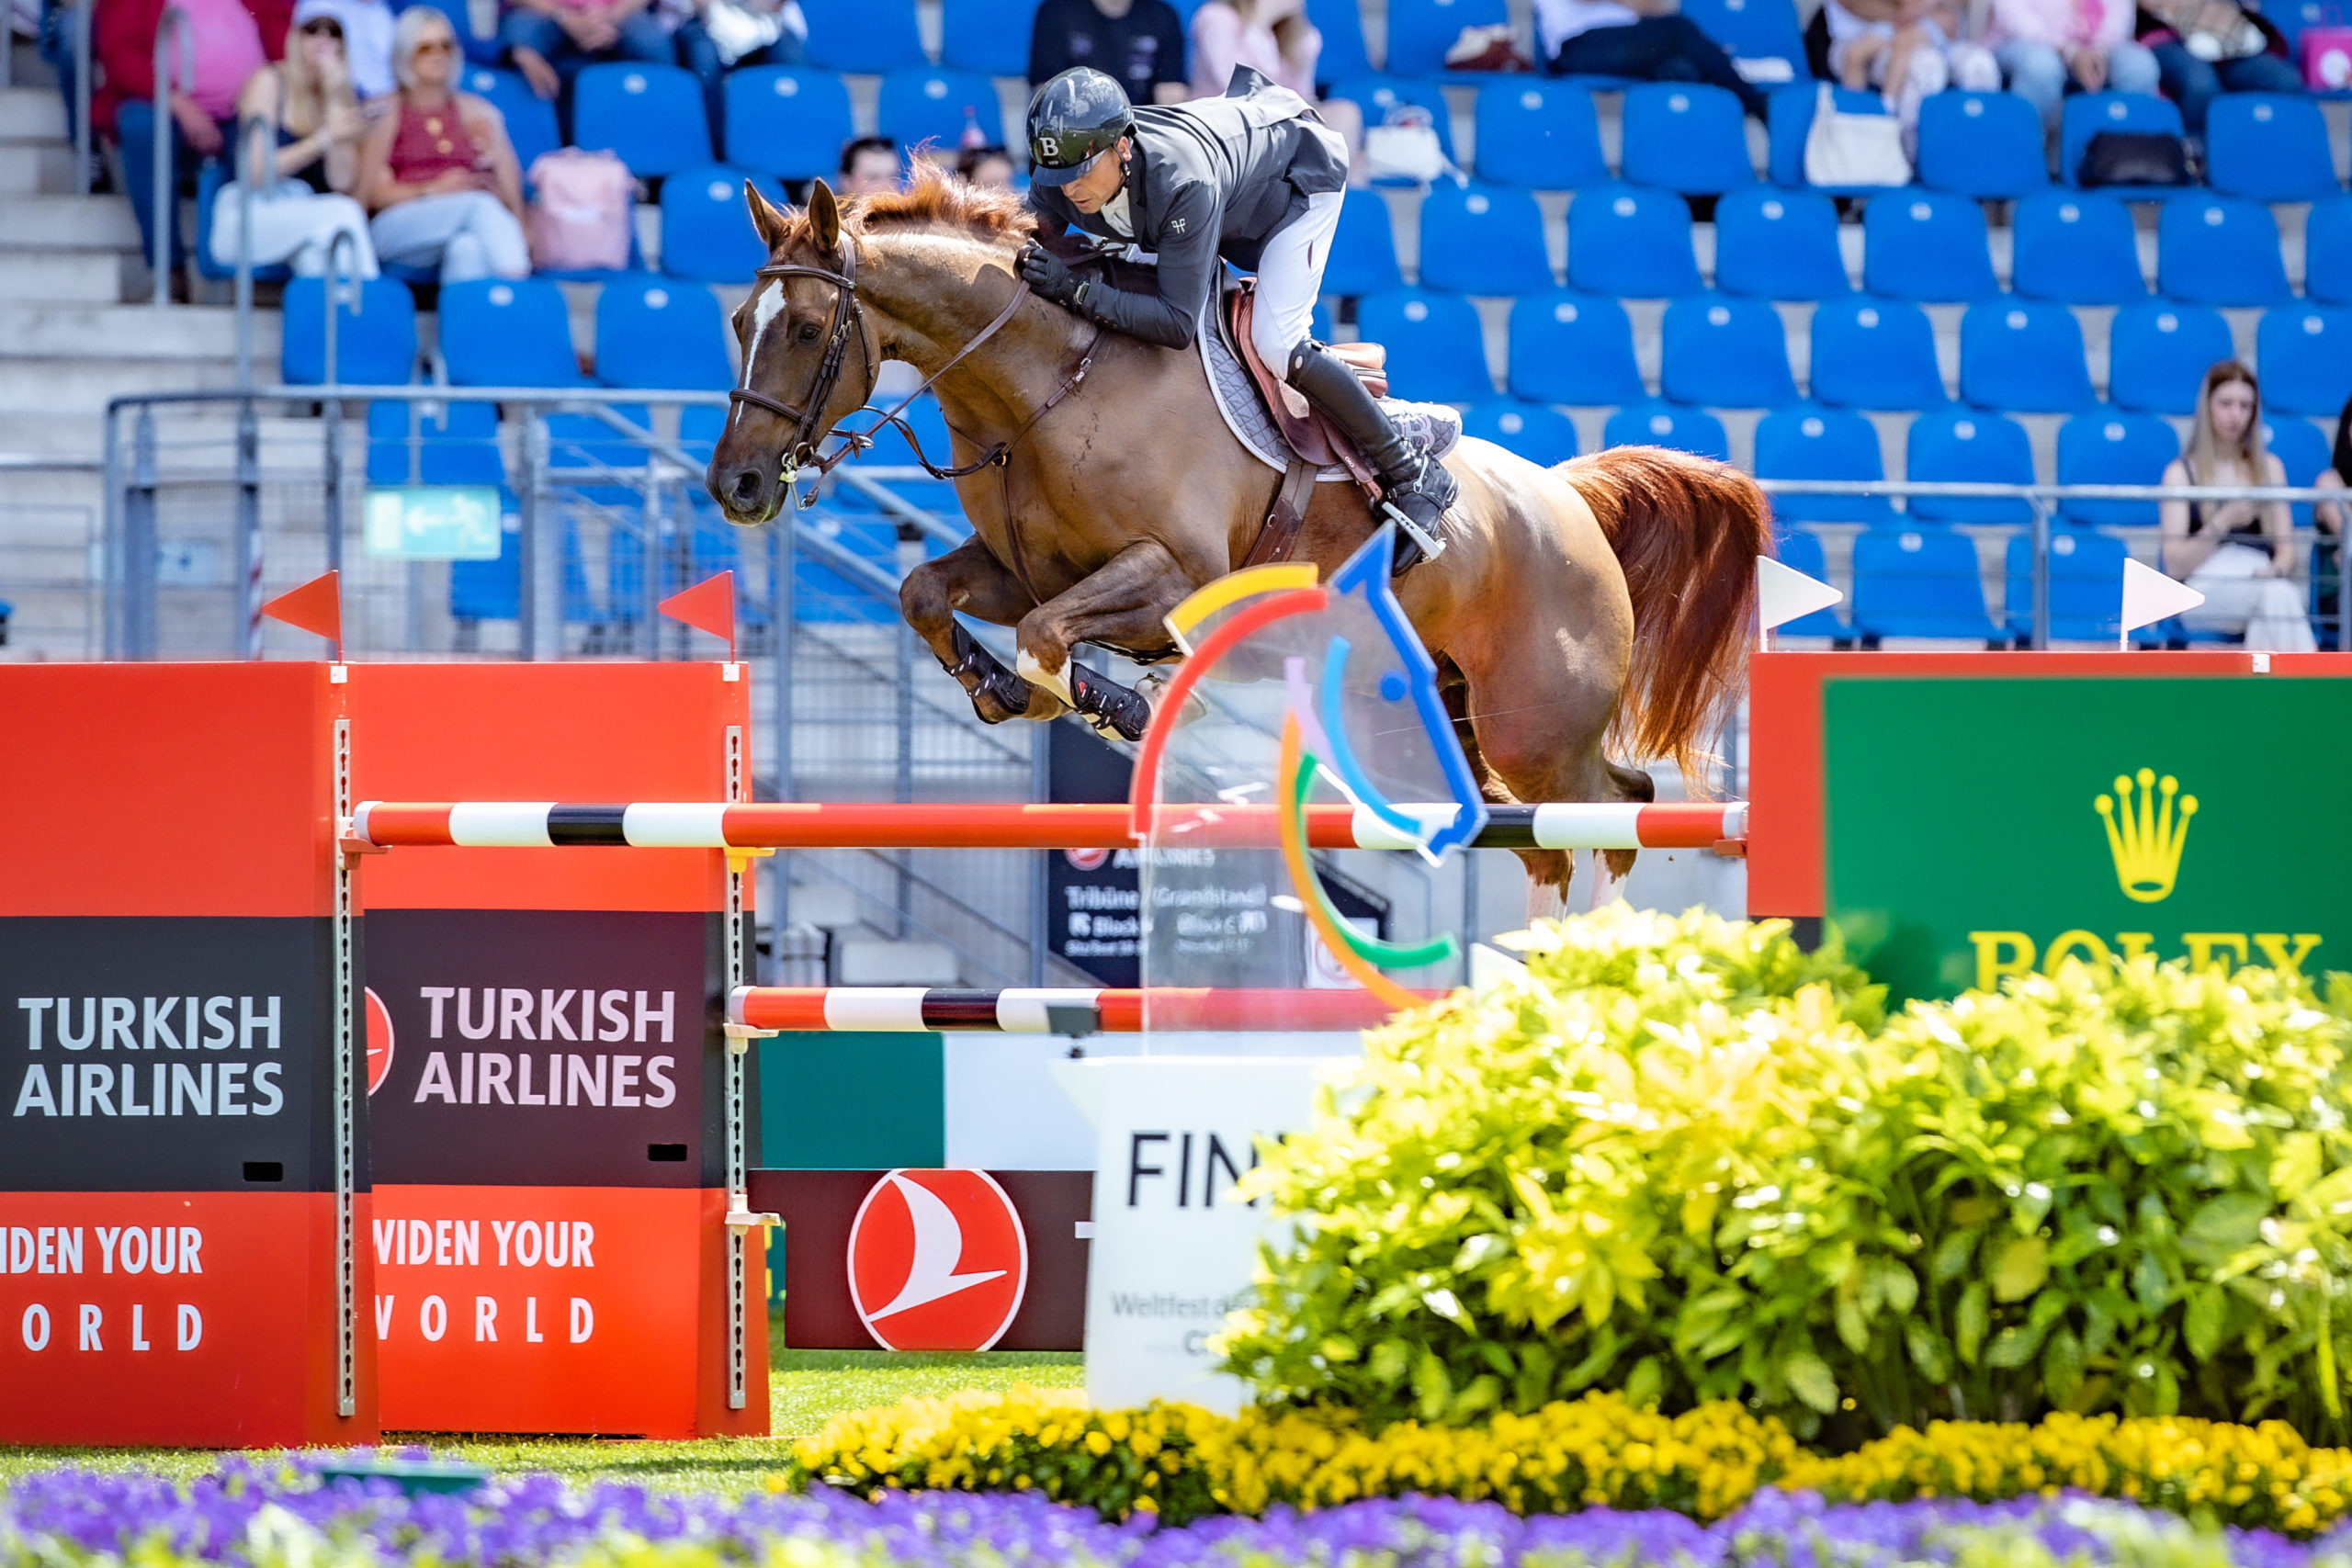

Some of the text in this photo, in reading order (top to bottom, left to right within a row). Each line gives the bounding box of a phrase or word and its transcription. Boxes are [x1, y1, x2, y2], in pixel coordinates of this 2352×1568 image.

[1039, 137, 1059, 157] B
[1968, 930, 2323, 998] ROEX
[17, 996, 282, 1051] TURKISH
[421, 987, 676, 1043] TURKISH
[13, 1062, 284, 1117] AIRLINES
[413, 1051, 677, 1109] AIRLINES
[1128, 1130, 1286, 1208] FIN
[0, 1226, 203, 1275] IDEN YOUR
[492, 1220, 595, 1268] YOUR
[22, 1303, 203, 1351] ORLD
